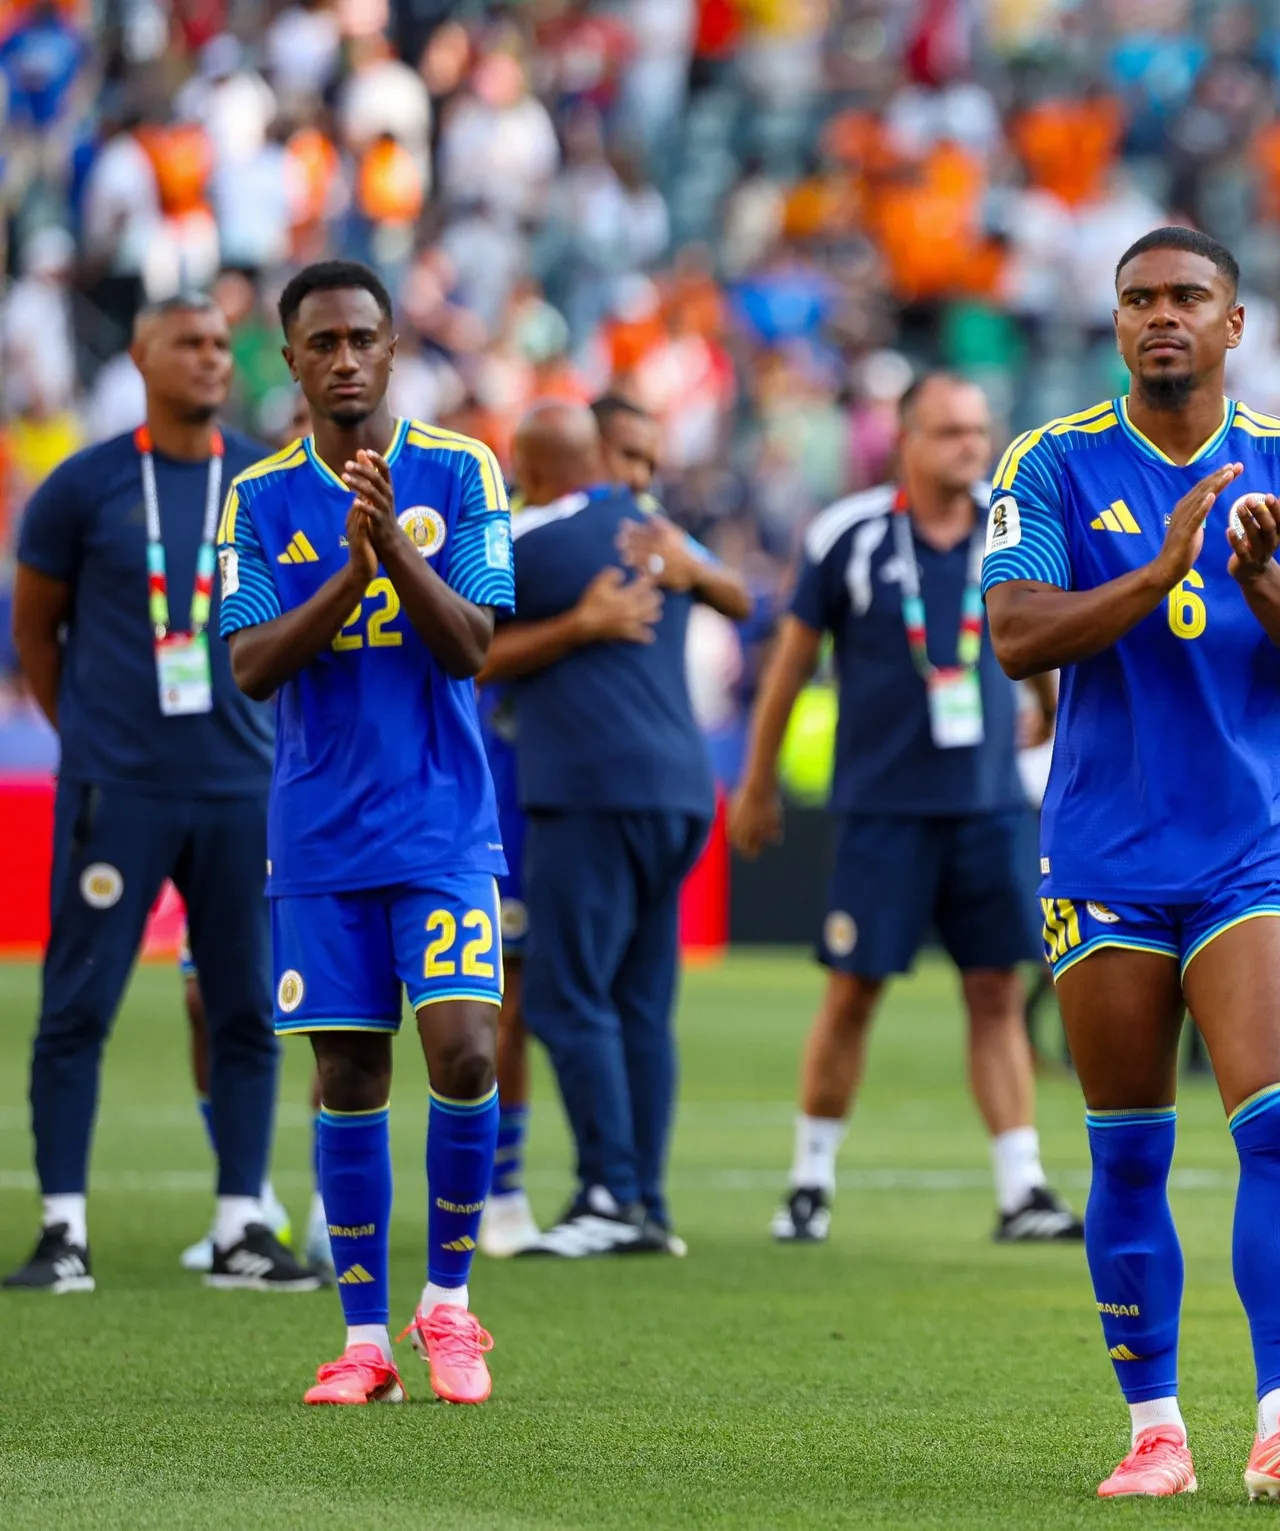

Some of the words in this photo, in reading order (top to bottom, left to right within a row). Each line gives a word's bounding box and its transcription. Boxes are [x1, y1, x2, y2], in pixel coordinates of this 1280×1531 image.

[1168, 568, 1207, 639] 6
[424, 908, 494, 979] 22
[1096, 1301, 1140, 1318] RAÇAO
